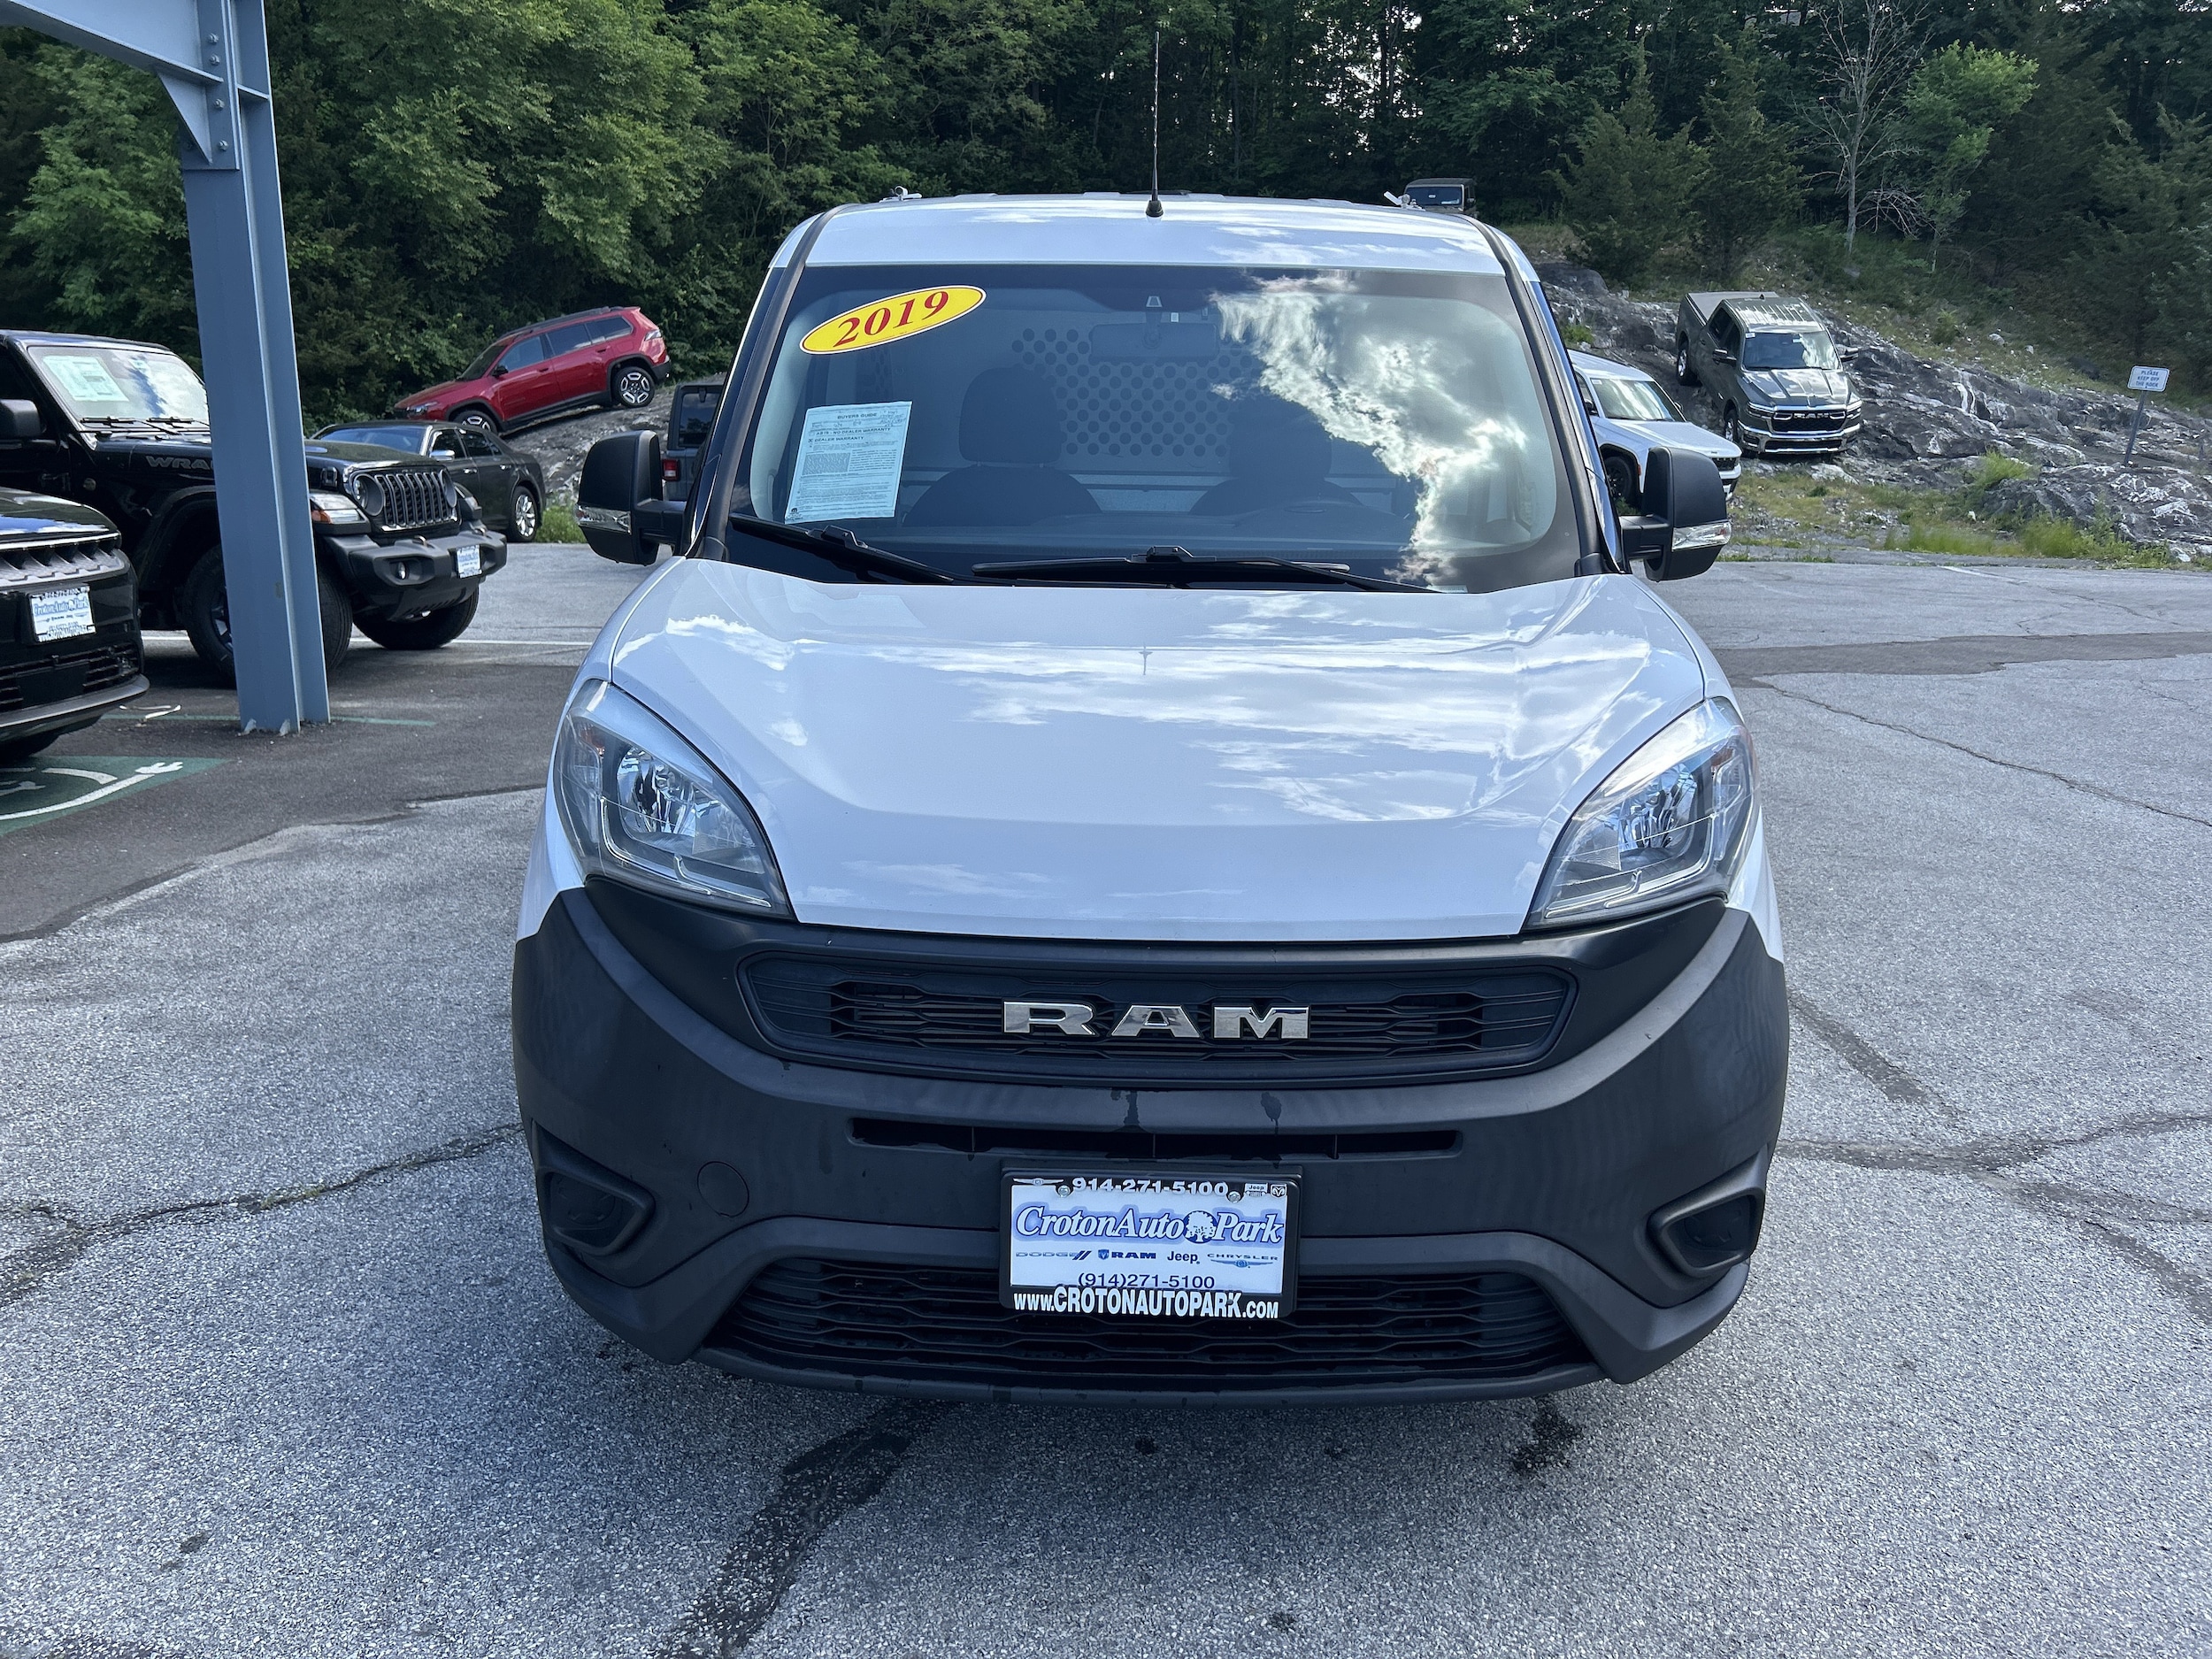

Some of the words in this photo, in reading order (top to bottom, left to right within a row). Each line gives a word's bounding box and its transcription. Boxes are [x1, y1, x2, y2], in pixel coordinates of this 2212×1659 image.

[833, 291, 949, 347] 2019
[145, 456, 214, 470] WRA
[1003, 1001, 1310, 1039] RAM
[1072, 1178, 1228, 1195] 914-271-5100
[1210, 1211, 1284, 1243] Park
[1111, 1251, 1156, 1260] RAM
[1167, 1250, 1198, 1263] Jeep
[1078, 1272, 1215, 1288] (914)271-5100
